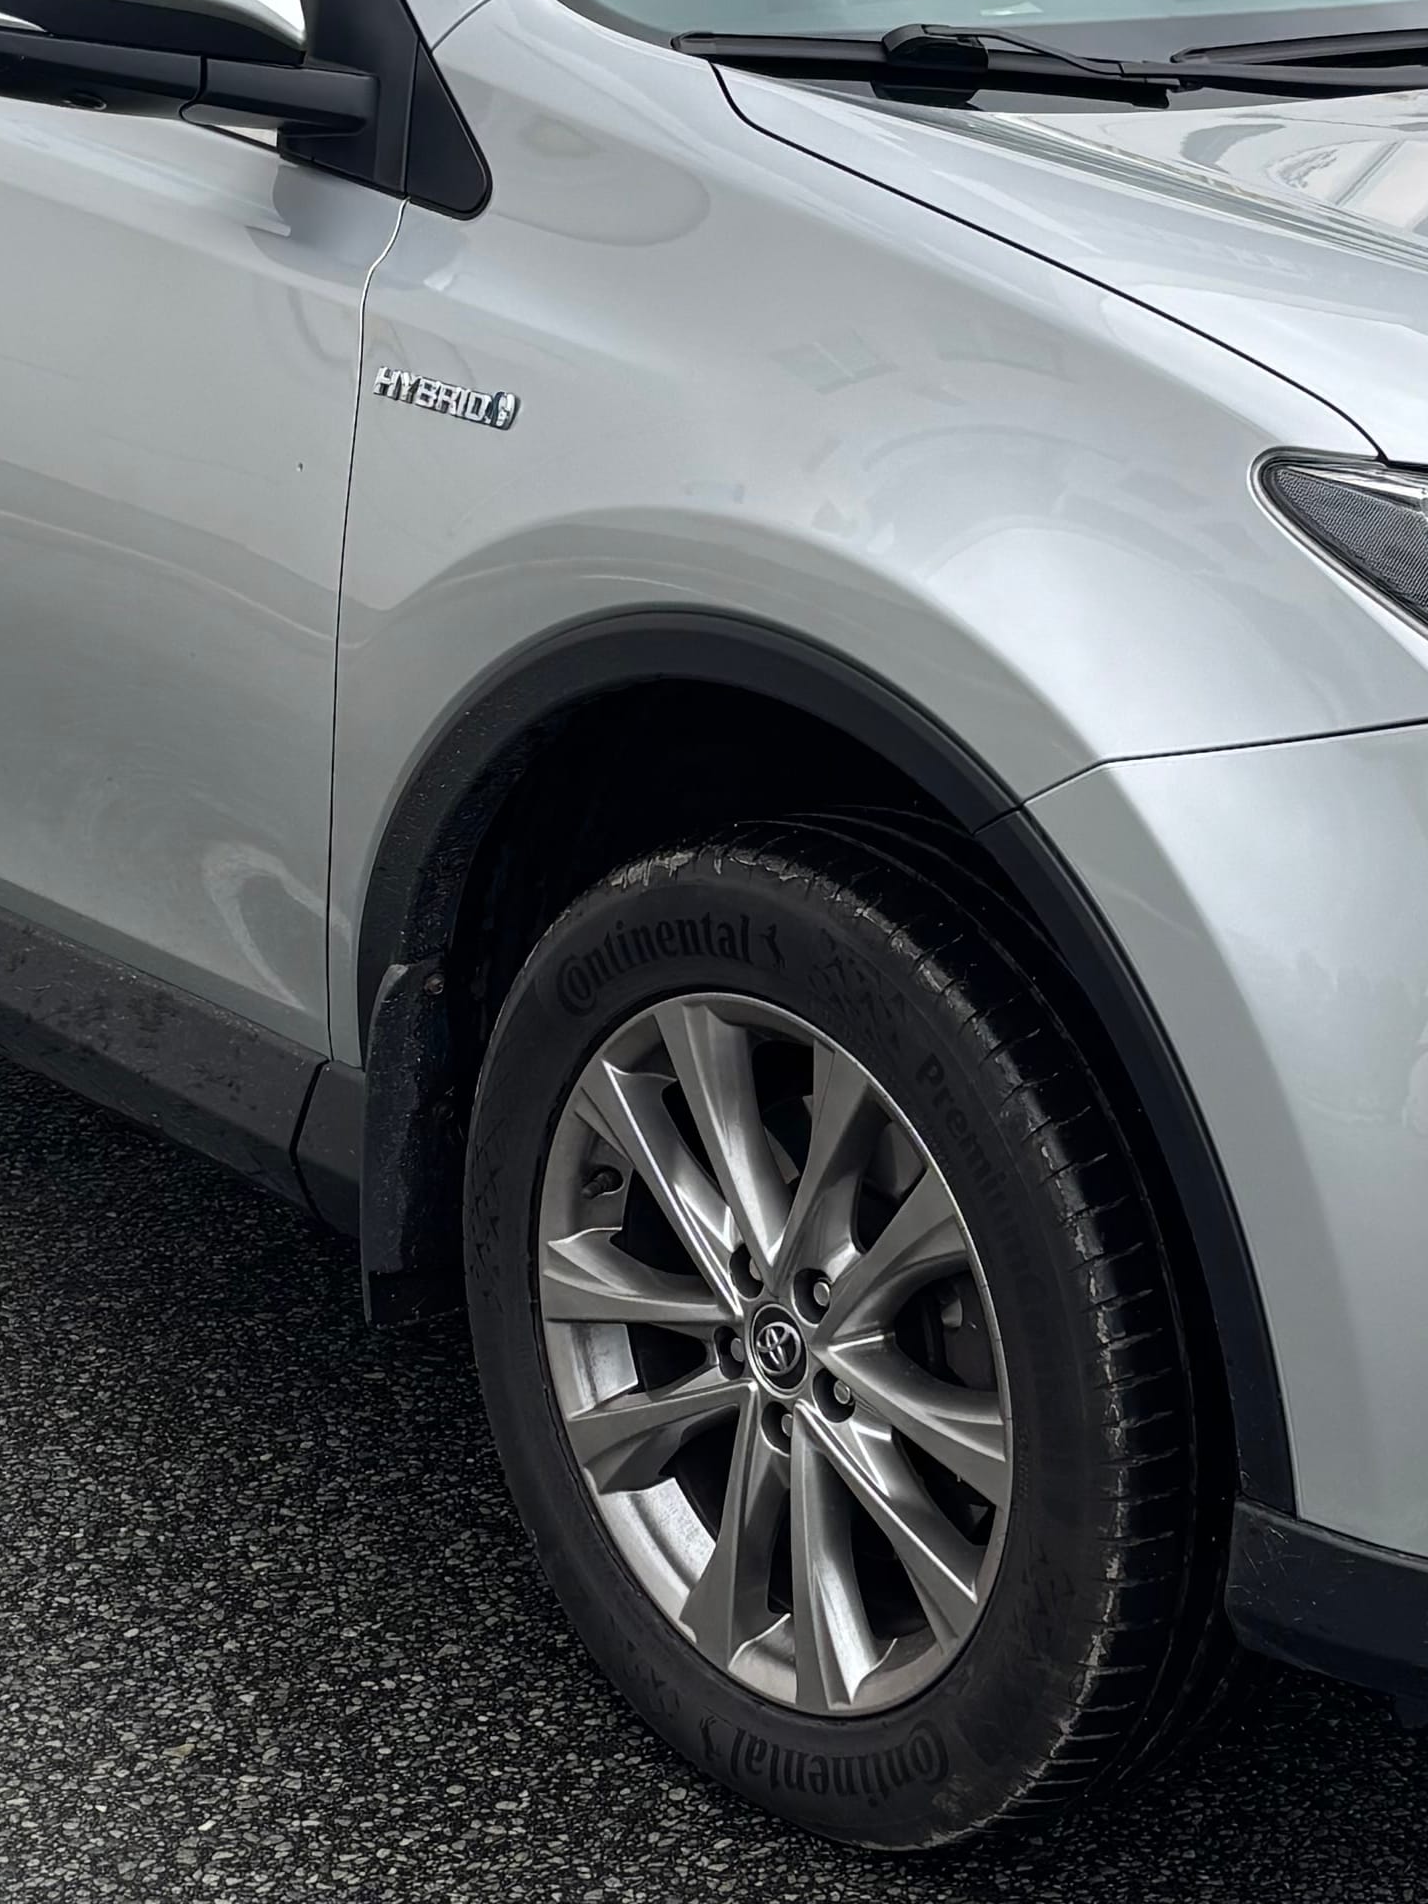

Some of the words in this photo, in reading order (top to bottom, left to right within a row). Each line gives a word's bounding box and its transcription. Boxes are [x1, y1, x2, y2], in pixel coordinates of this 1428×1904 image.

[373, 366, 491, 425] HYBRID
[557, 911, 754, 1017] Continental
[729, 1718, 949, 1808] Continental
